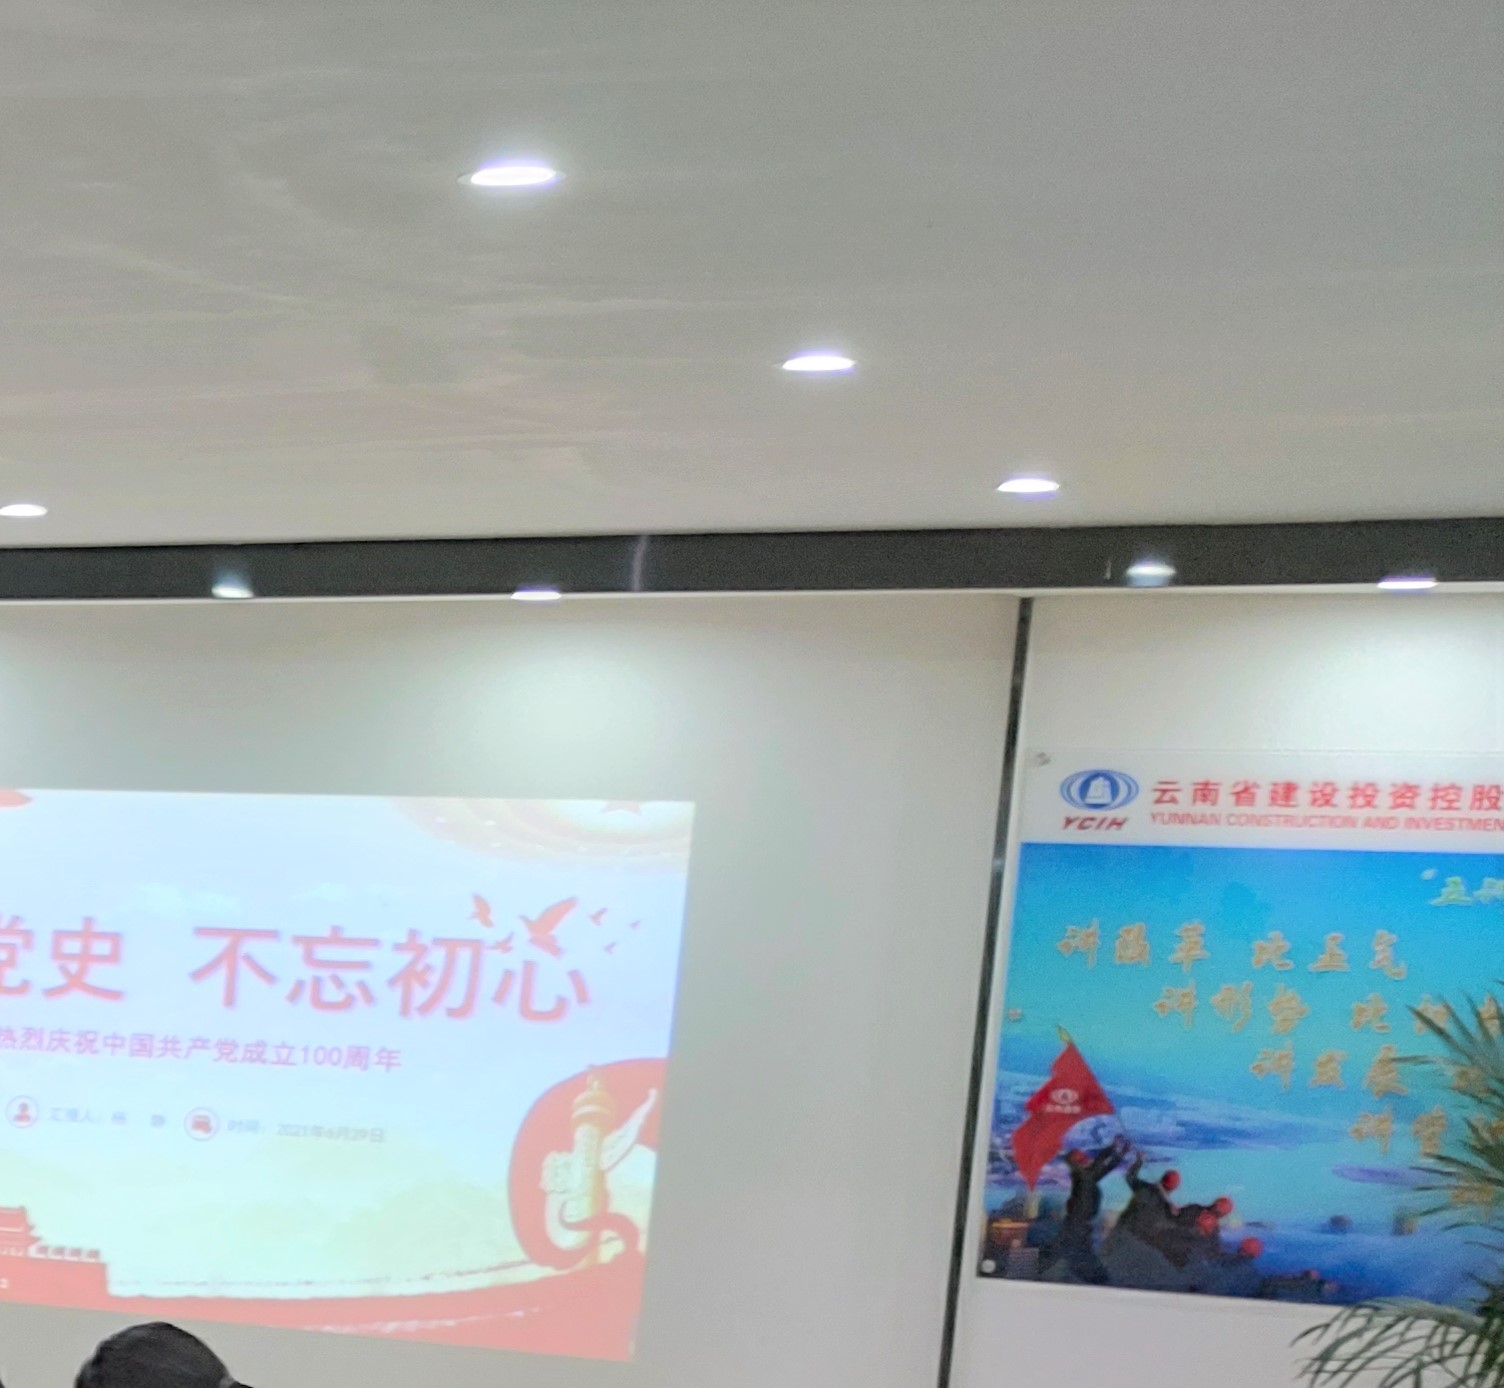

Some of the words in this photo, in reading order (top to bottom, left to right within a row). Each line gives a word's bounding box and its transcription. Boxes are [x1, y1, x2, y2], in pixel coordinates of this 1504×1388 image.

[1061, 815, 1130, 832] YCIH
[1151, 812, 1222, 826] YUNNAN
[1226, 813, 1357, 829] CONSTRUCTION
[1363, 816, 1399, 830] AND
[189, 922, 590, 1024] 不忘初心
